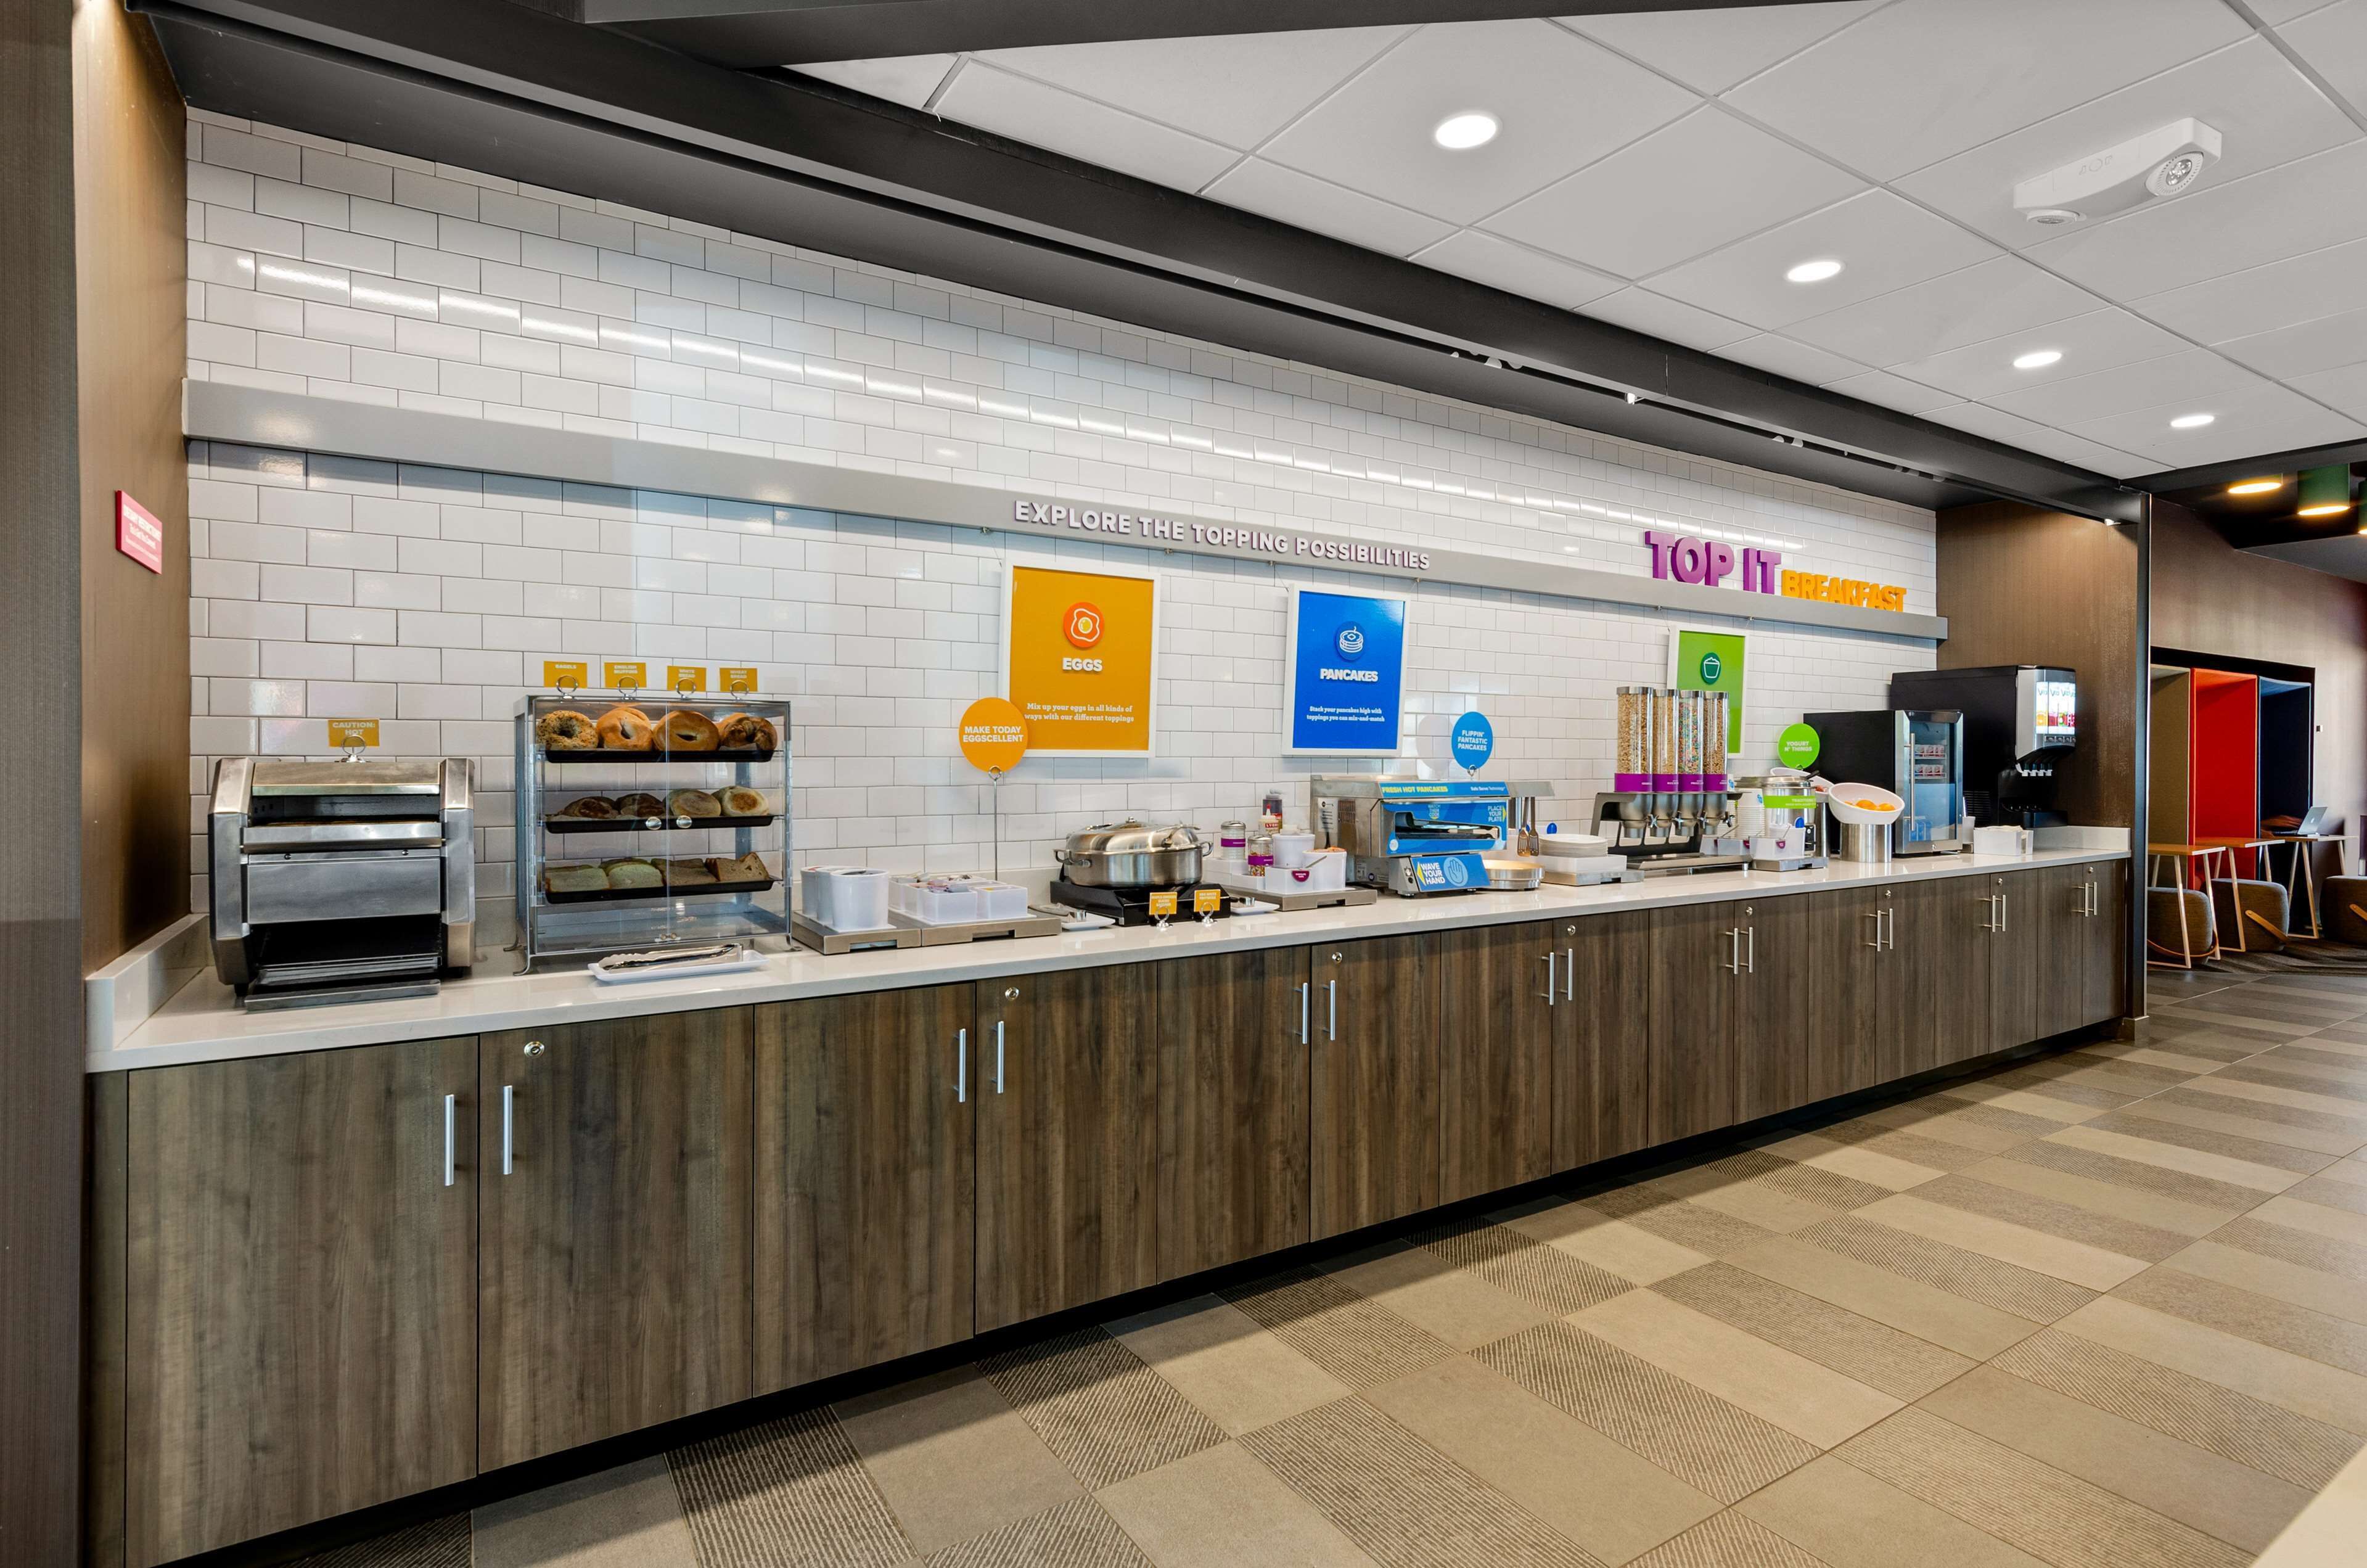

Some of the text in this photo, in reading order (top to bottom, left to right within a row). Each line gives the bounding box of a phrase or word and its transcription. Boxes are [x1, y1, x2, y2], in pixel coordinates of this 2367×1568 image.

[1015, 500, 1430, 570] EXPLORE THE TOPPING POSSIBILITIES
[1645, 530, 1781, 595] TOP IT
[1781, 569, 1907, 612] BREAKFAST
[1062, 657, 1102, 672] EGGS
[1320, 668, 1378, 682] PANCAKES
[1105, 715, 1134, 723] toppings
[965, 726, 1021, 734] MAKE TODAY
[963, 734, 1024, 742] EGGSCELLENT
[1458, 736, 1488, 744] FANTASTIC
[1458, 743, 1487, 751] PANCAKES
